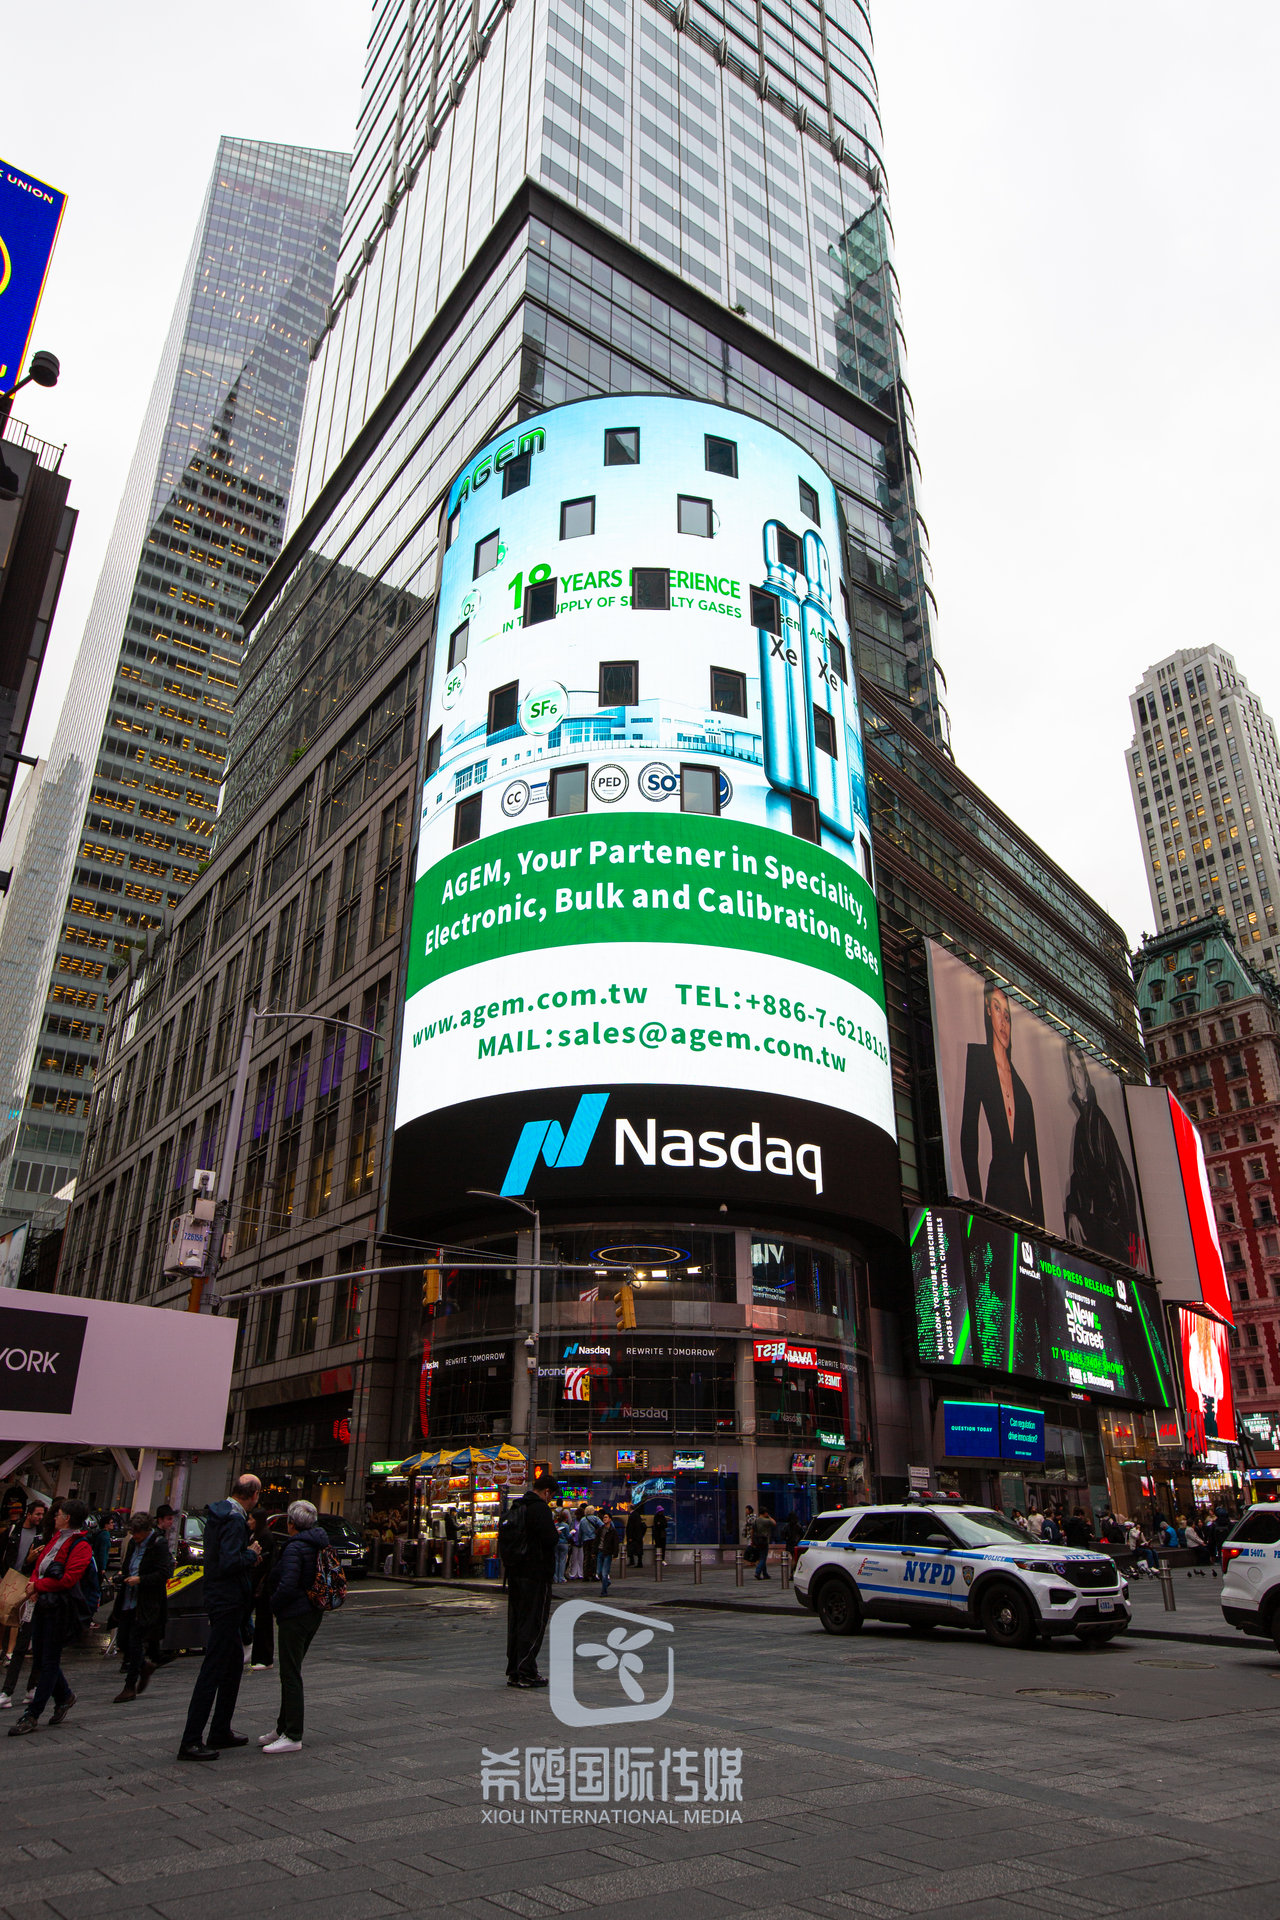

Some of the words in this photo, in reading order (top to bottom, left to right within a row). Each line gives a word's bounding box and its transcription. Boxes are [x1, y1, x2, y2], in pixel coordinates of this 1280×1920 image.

[7, 173, 53, 204] UNION
[560, 570, 622, 593] YEARS
[629, 570, 741, 599] ERIENCE
[502, 619, 514, 633] IN
[600, 596, 616, 607] OF
[699, 599, 742, 618] GASES
[770, 635, 798, 666] Xe
[817, 656, 838, 692] Xe
[530, 699, 558, 719] SF6
[507, 791, 522, 805] CC
[598, 777, 621, 788] PED
[441, 859, 511, 905] AGEM,
[517, 846, 583, 875] Your
[589, 840, 726, 869] Partener
[732, 845, 758, 875] in
[764, 855, 868, 930] Speciality,
[424, 893, 547, 956] Electronic,
[555, 882, 624, 913] Bulk
[632, 884, 690, 910] and
[698, 887, 841, 947] Calibration
[844, 933, 879, 976] gases
[412, 983, 648, 1048] www.agem.com.tw
[478, 1021, 846, 1073] MAIL:sales@agem.com.tw
[615, 1118, 823, 1195] Nasdaq
[926, 1211, 937, 1267] SUBSCRIBERS
[936, 1217, 946, 1262] CHANNELS
[931, 1269, 940, 1309] YOUTUBE
[940, 1263, 949, 1298] DIGITAL
[1040, 1260, 1061, 1278] VIDEO
[1062, 1268, 1083, 1286] PRESS
[1084, 1276, 1114, 1298] RELEASES
[935, 1311, 944, 1352] MILLION+
[946, 1320, 954, 1355] ACROSS
[1076, 1323, 1104, 1350] Street
[579, 1345, 611, 1356] Nasdaq
[626, 1347, 664, 1355] REWRITE
[667, 1347, 716, 1357] TOMORROW
[1051, 1346, 1059, 1359] 17
[1102, 1360, 1125, 1376] SHOWS
[623, 1406, 668, 1421] Nasdaq
[903, 1560, 956, 1586] NYPD
